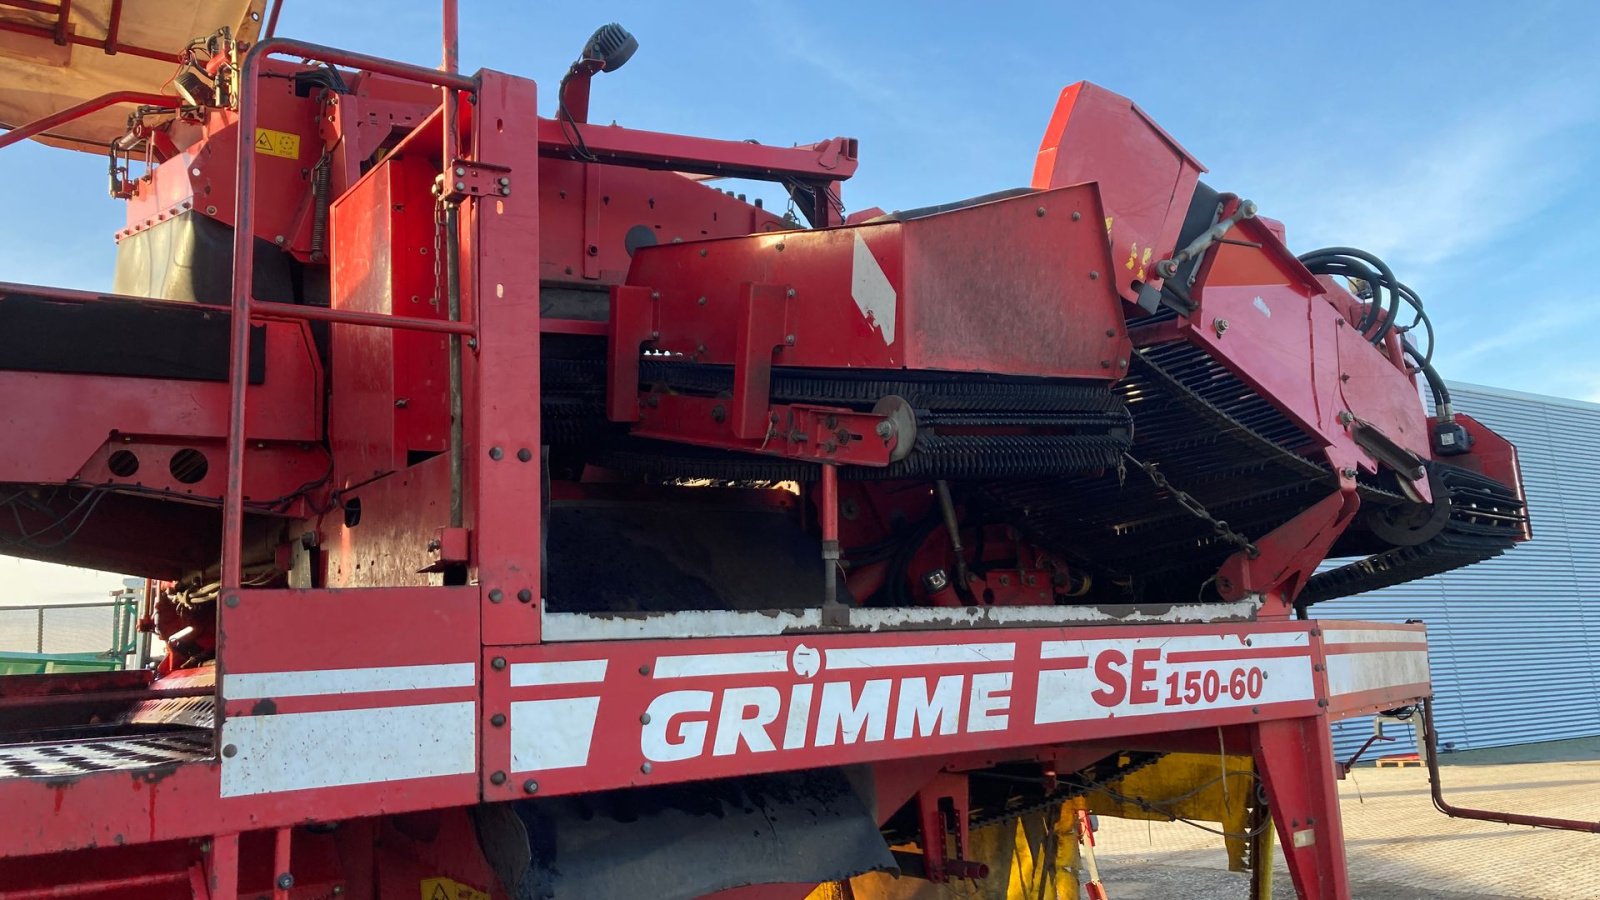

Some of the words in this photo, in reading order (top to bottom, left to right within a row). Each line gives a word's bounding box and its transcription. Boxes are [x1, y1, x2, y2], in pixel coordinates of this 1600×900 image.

[641, 644, 1013, 762] GRIMME
[1091, 648, 1161, 707] SE
[1165, 667, 1263, 706] 150-60
